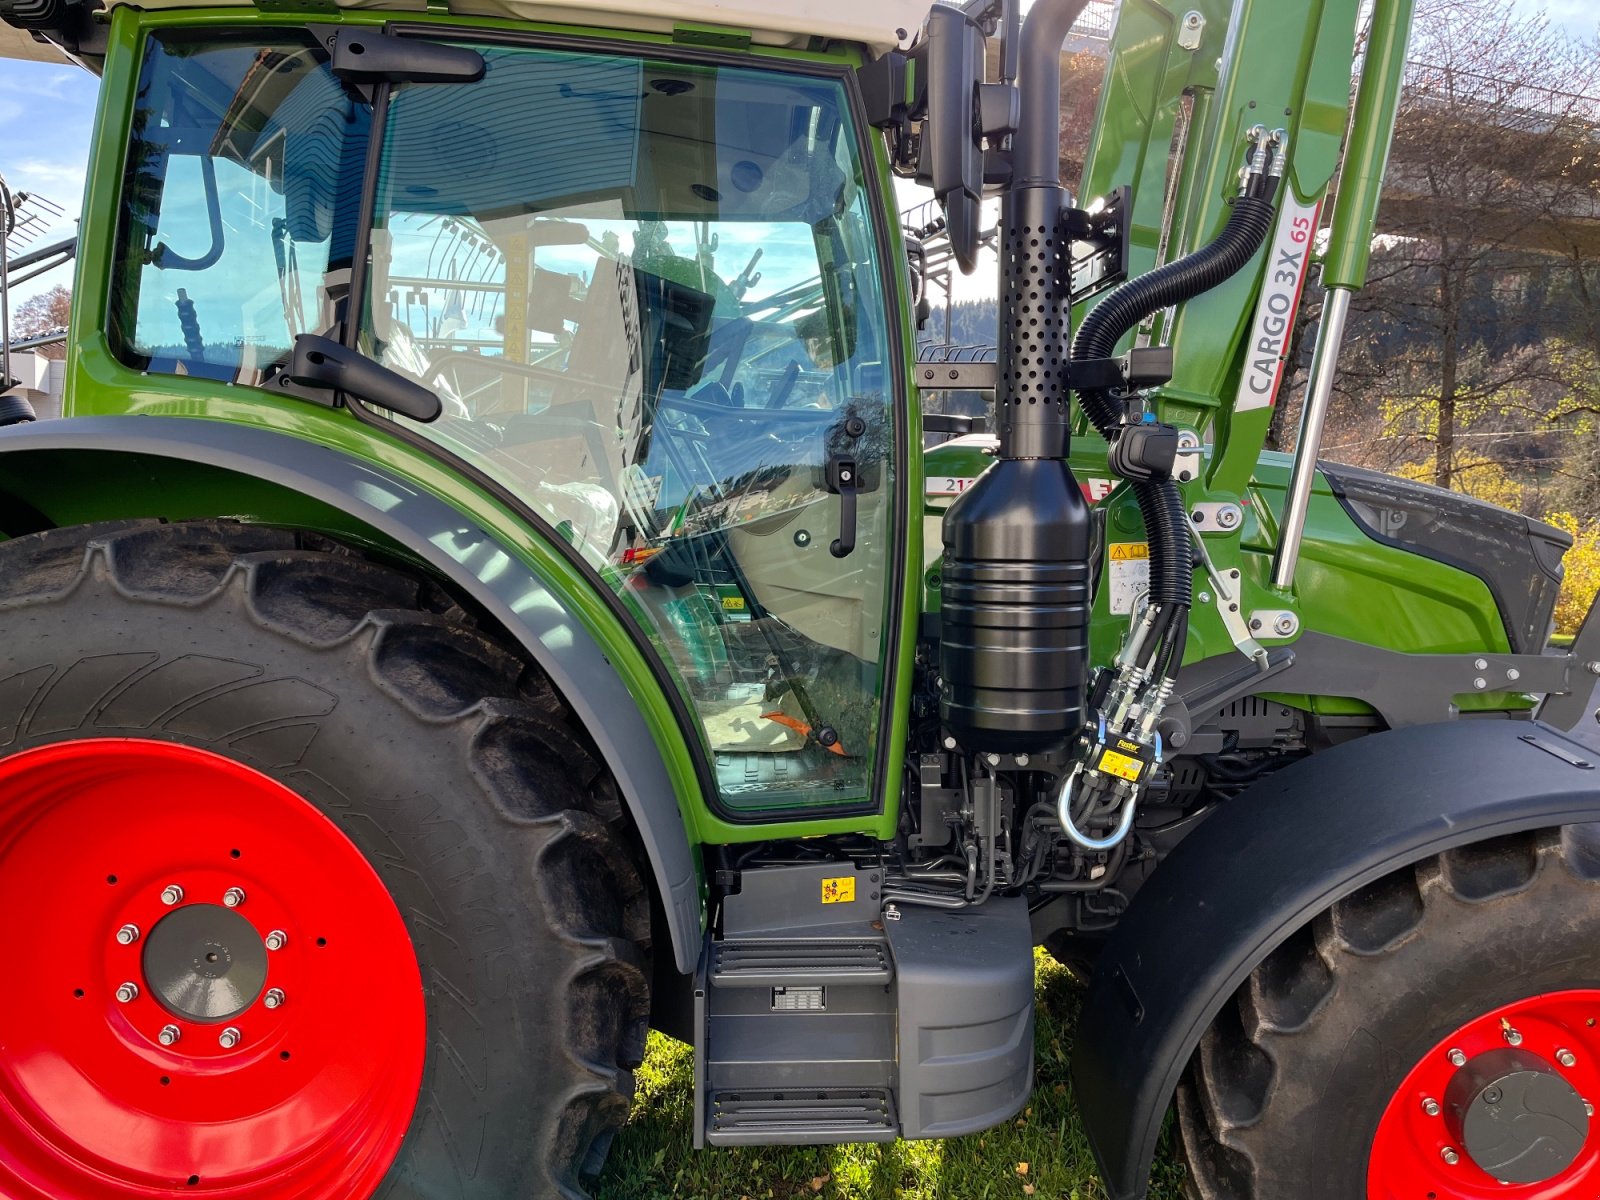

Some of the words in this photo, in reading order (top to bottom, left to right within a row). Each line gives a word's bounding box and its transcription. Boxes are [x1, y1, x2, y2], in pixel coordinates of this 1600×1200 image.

[1249, 293, 1291, 395] CARGO
[1274, 248, 1303, 287] 3X
[1290, 216, 1309, 244] 65
